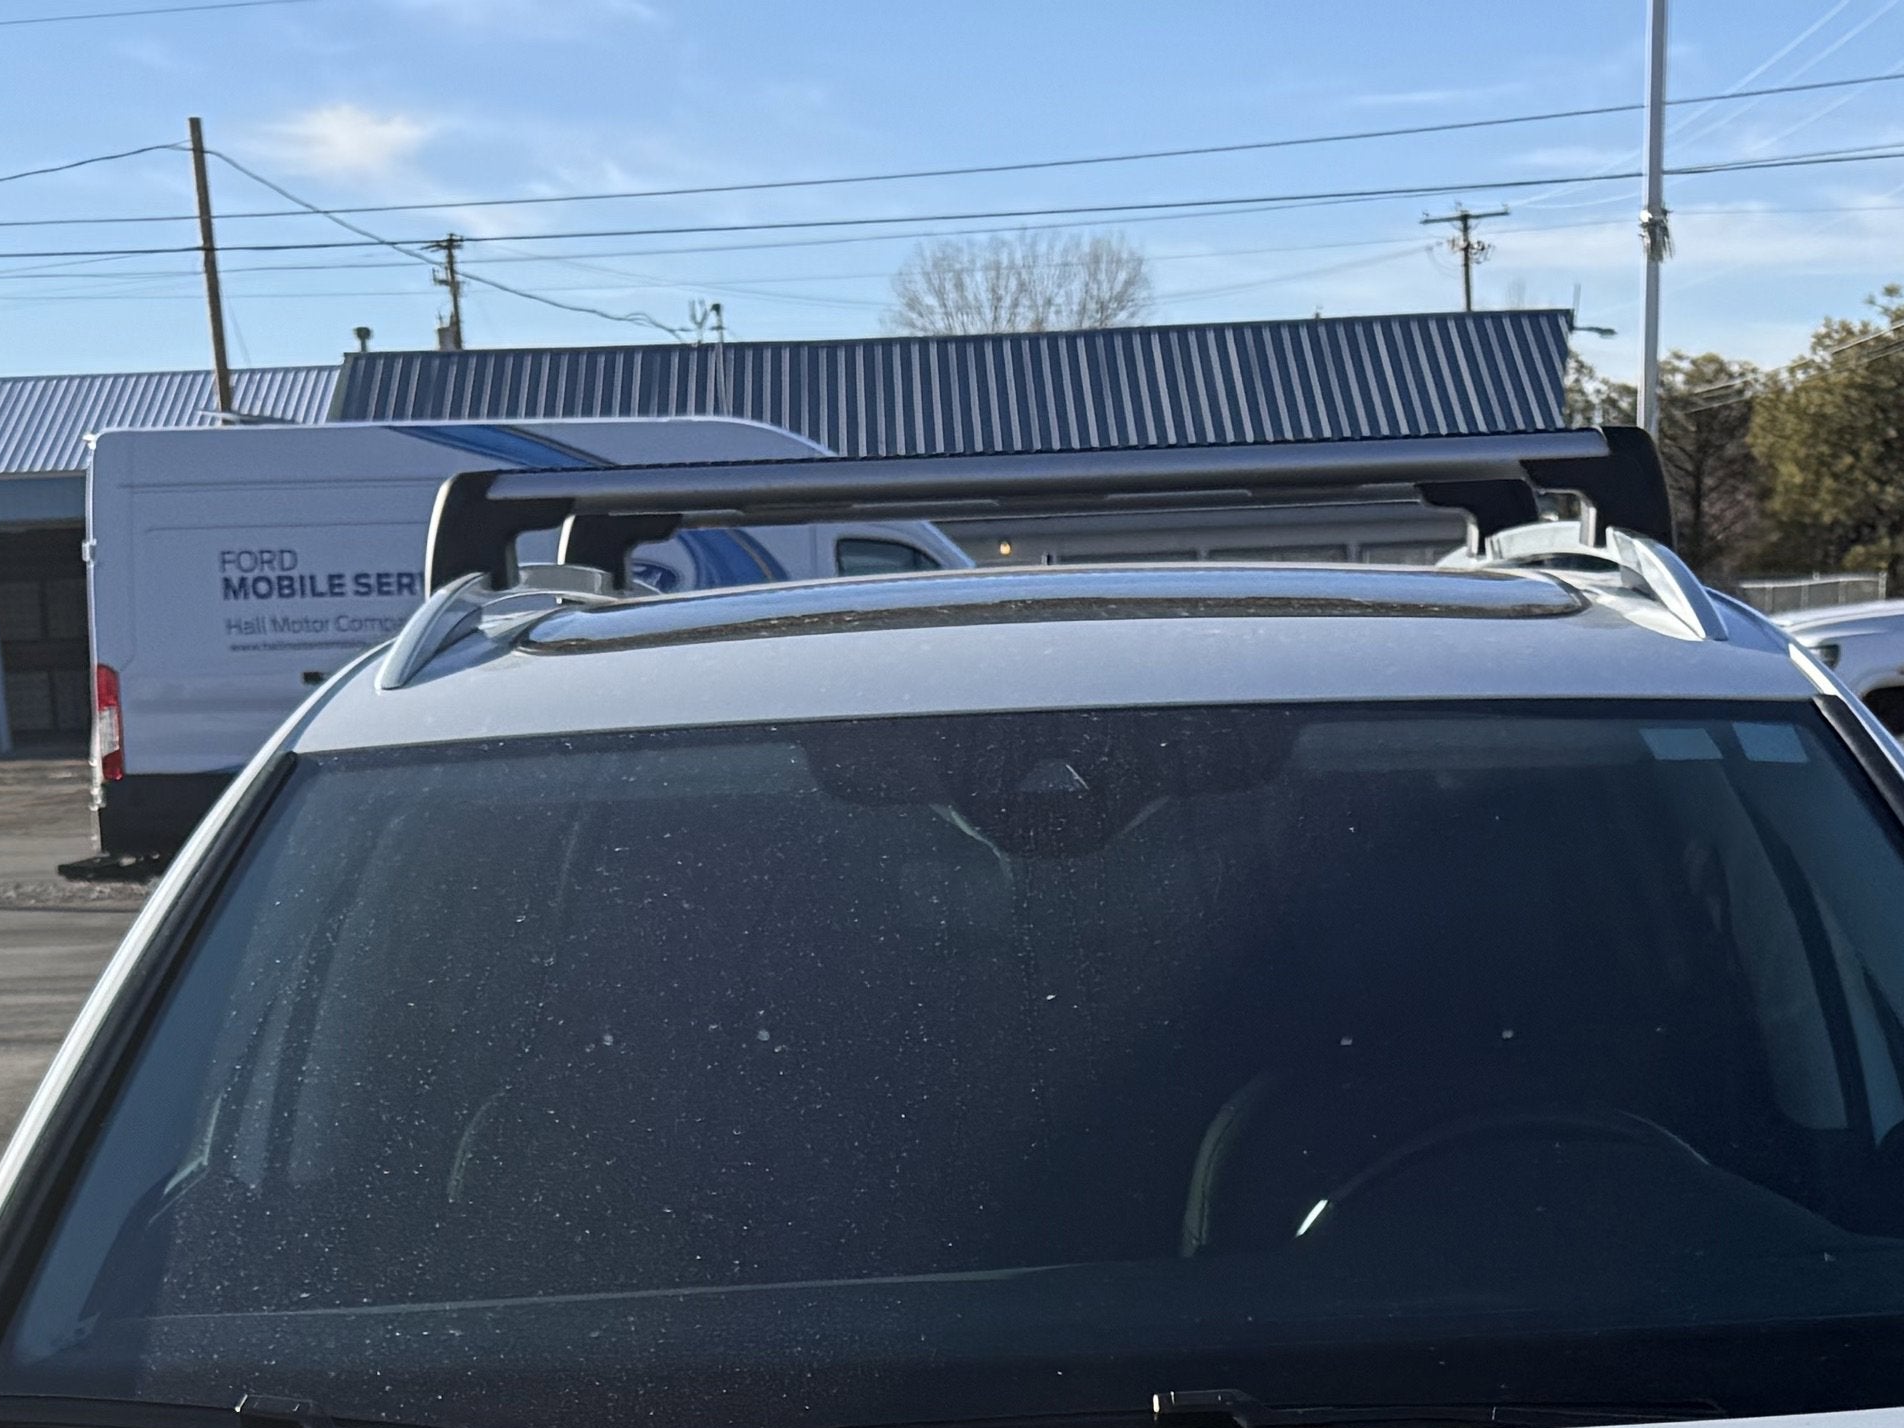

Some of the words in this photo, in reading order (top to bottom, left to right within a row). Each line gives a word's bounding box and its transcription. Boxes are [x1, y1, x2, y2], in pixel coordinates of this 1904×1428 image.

[220, 549, 298, 573] FORD
[222, 573, 346, 600] MOBILE
[225, 616, 268, 636] Hall
[271, 615, 330, 635] Motor
